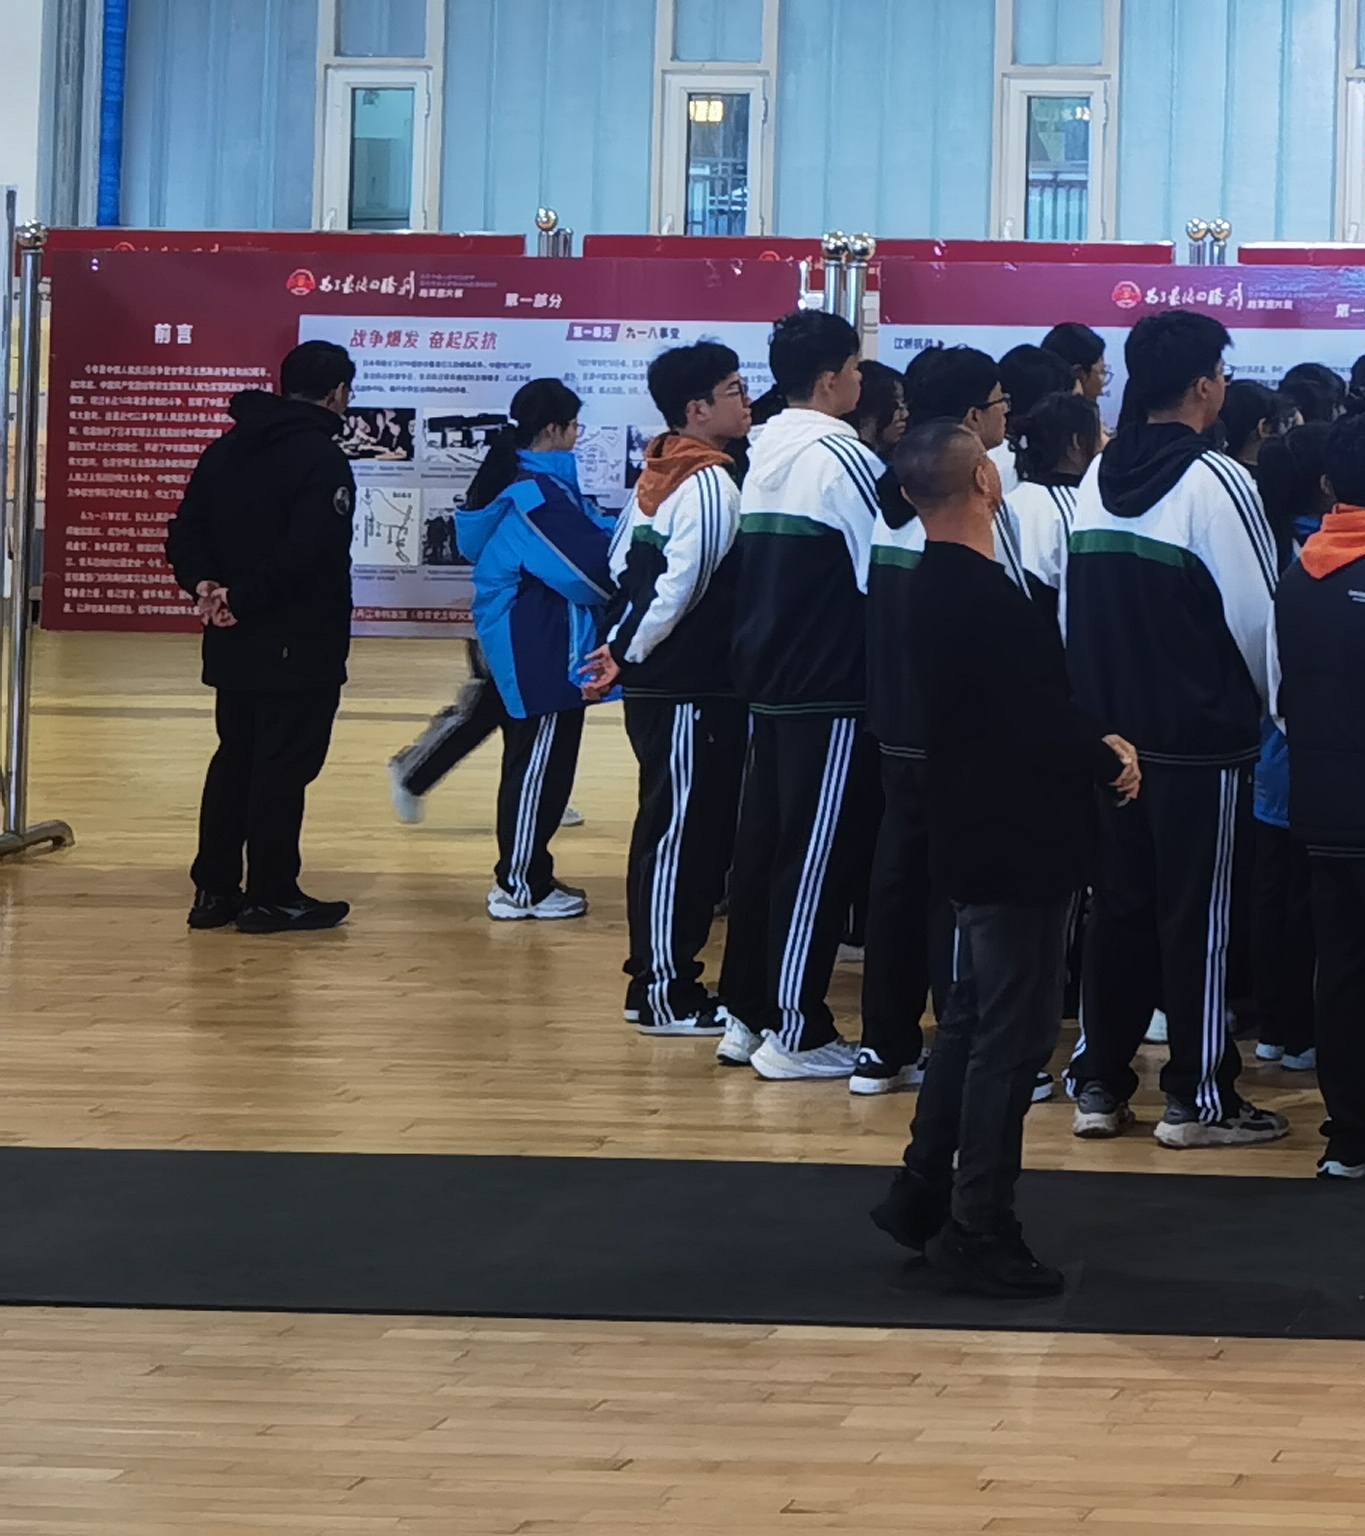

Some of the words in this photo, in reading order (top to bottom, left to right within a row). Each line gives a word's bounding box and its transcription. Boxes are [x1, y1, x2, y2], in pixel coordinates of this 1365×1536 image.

[504, 292, 563, 309] 第一部分
[154, 323, 194, 345] 前言
[350, 329, 420, 349] 战争爆发
[428, 330, 498, 350] 奋起反抗
